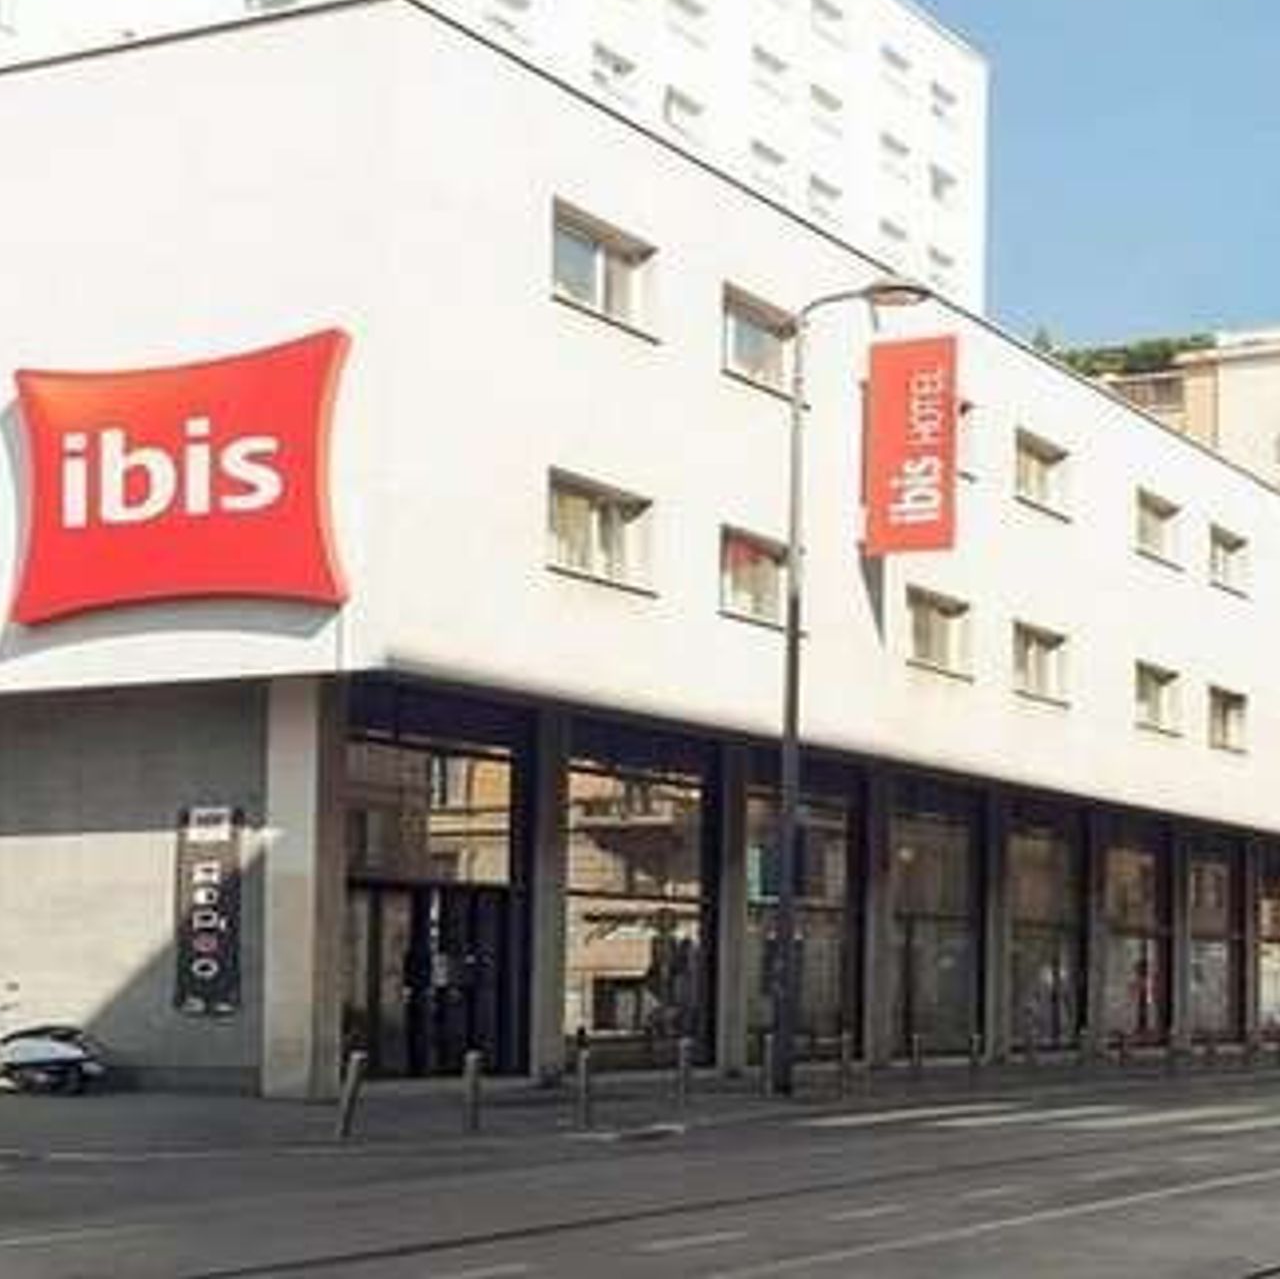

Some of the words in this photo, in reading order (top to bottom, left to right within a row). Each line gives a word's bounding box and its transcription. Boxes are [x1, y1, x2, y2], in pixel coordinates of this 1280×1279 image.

[908, 367, 942, 446] HOTEL
[61, 415, 284, 530] ibis
[888, 455, 942, 525] ibis
